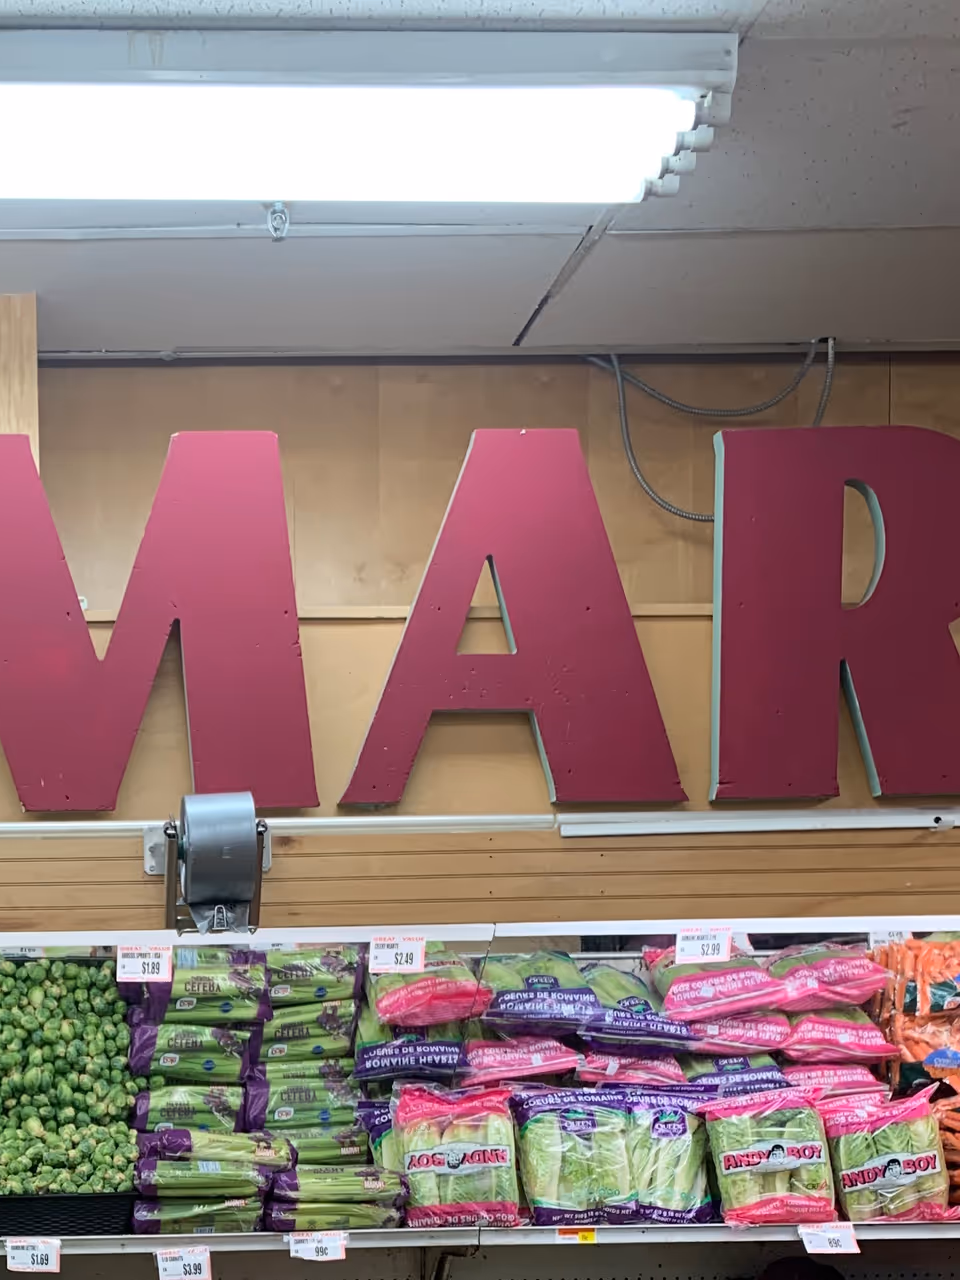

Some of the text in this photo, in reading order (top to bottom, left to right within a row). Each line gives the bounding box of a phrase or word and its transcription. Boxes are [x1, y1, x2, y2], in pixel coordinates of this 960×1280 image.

[701, 943, 720, 956] $2.99
[394, 952, 414, 965] $2.49
[142, 962, 160, 975] $1.89
[523, 1096, 560, 1108] COEURS
[578, 1092, 623, 1102] ROMAINE
[407, 1149, 507, 1170] ANDY BOY
[723, 1144, 822, 1170] ANDY BOY
[841, 1164, 887, 1189] ANDY
[902, 1155, 937, 1173] BOY
[31, 1253, 49, 1266] $1.69
[183, 1263, 202, 1276] $3.99
